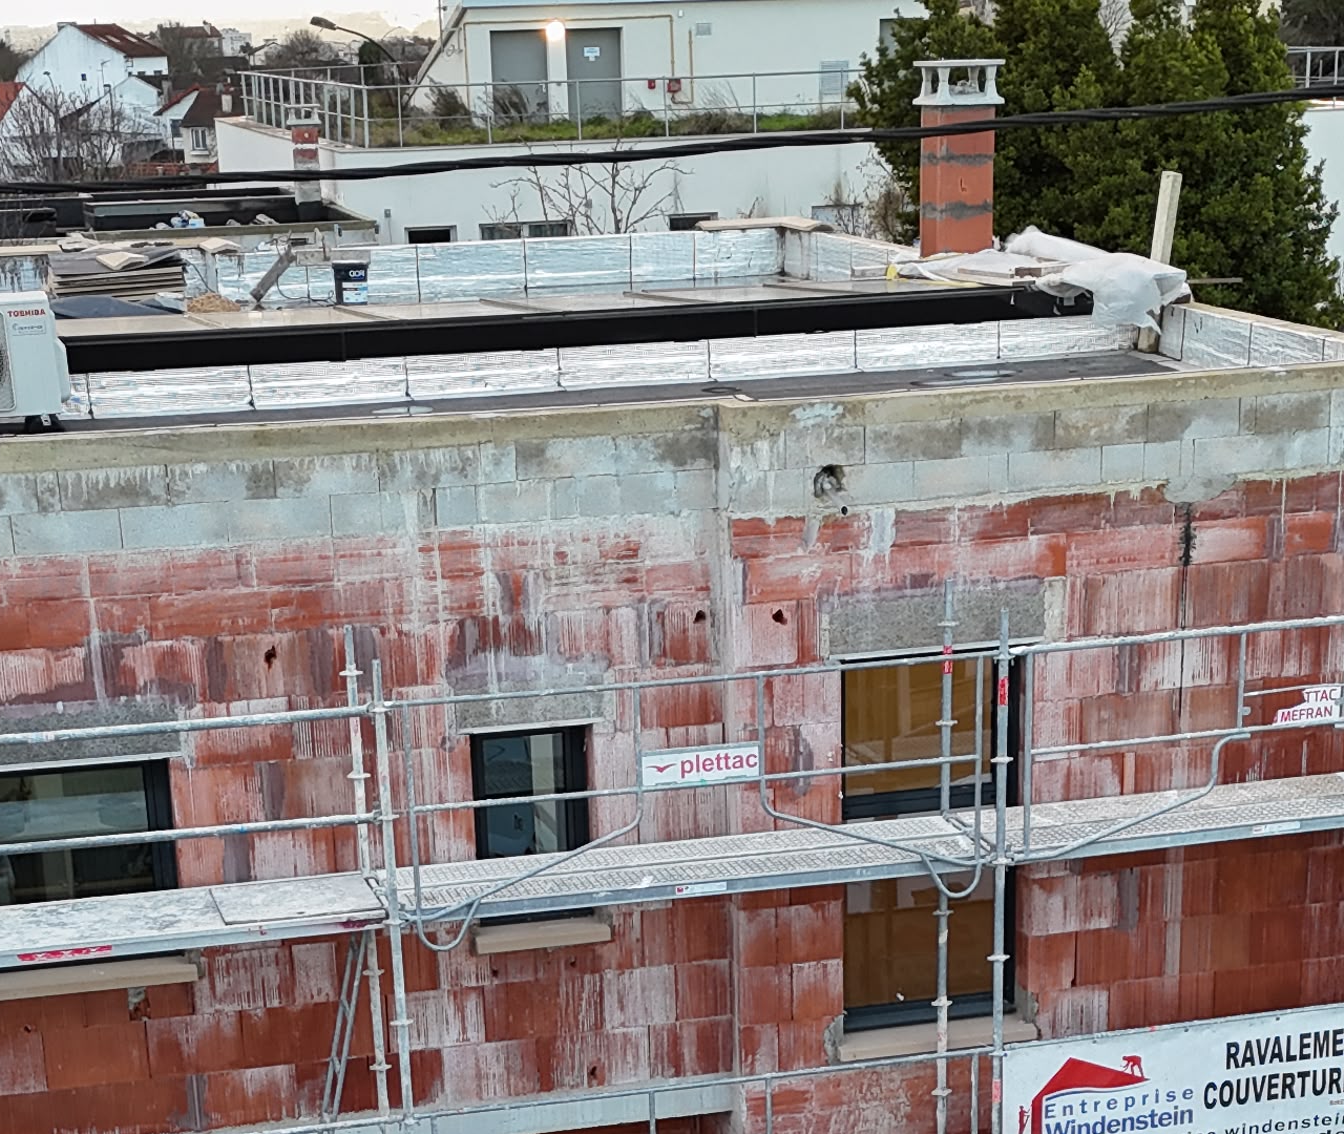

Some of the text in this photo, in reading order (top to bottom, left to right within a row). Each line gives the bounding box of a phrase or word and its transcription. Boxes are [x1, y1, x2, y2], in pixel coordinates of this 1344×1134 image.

[7, 308, 46, 317] TOSHIBA
[1280, 705, 1333, 722] MEFRAN
[680, 752, 758, 779] plettac
[1045, 1087, 1194, 1119] Entreprise
